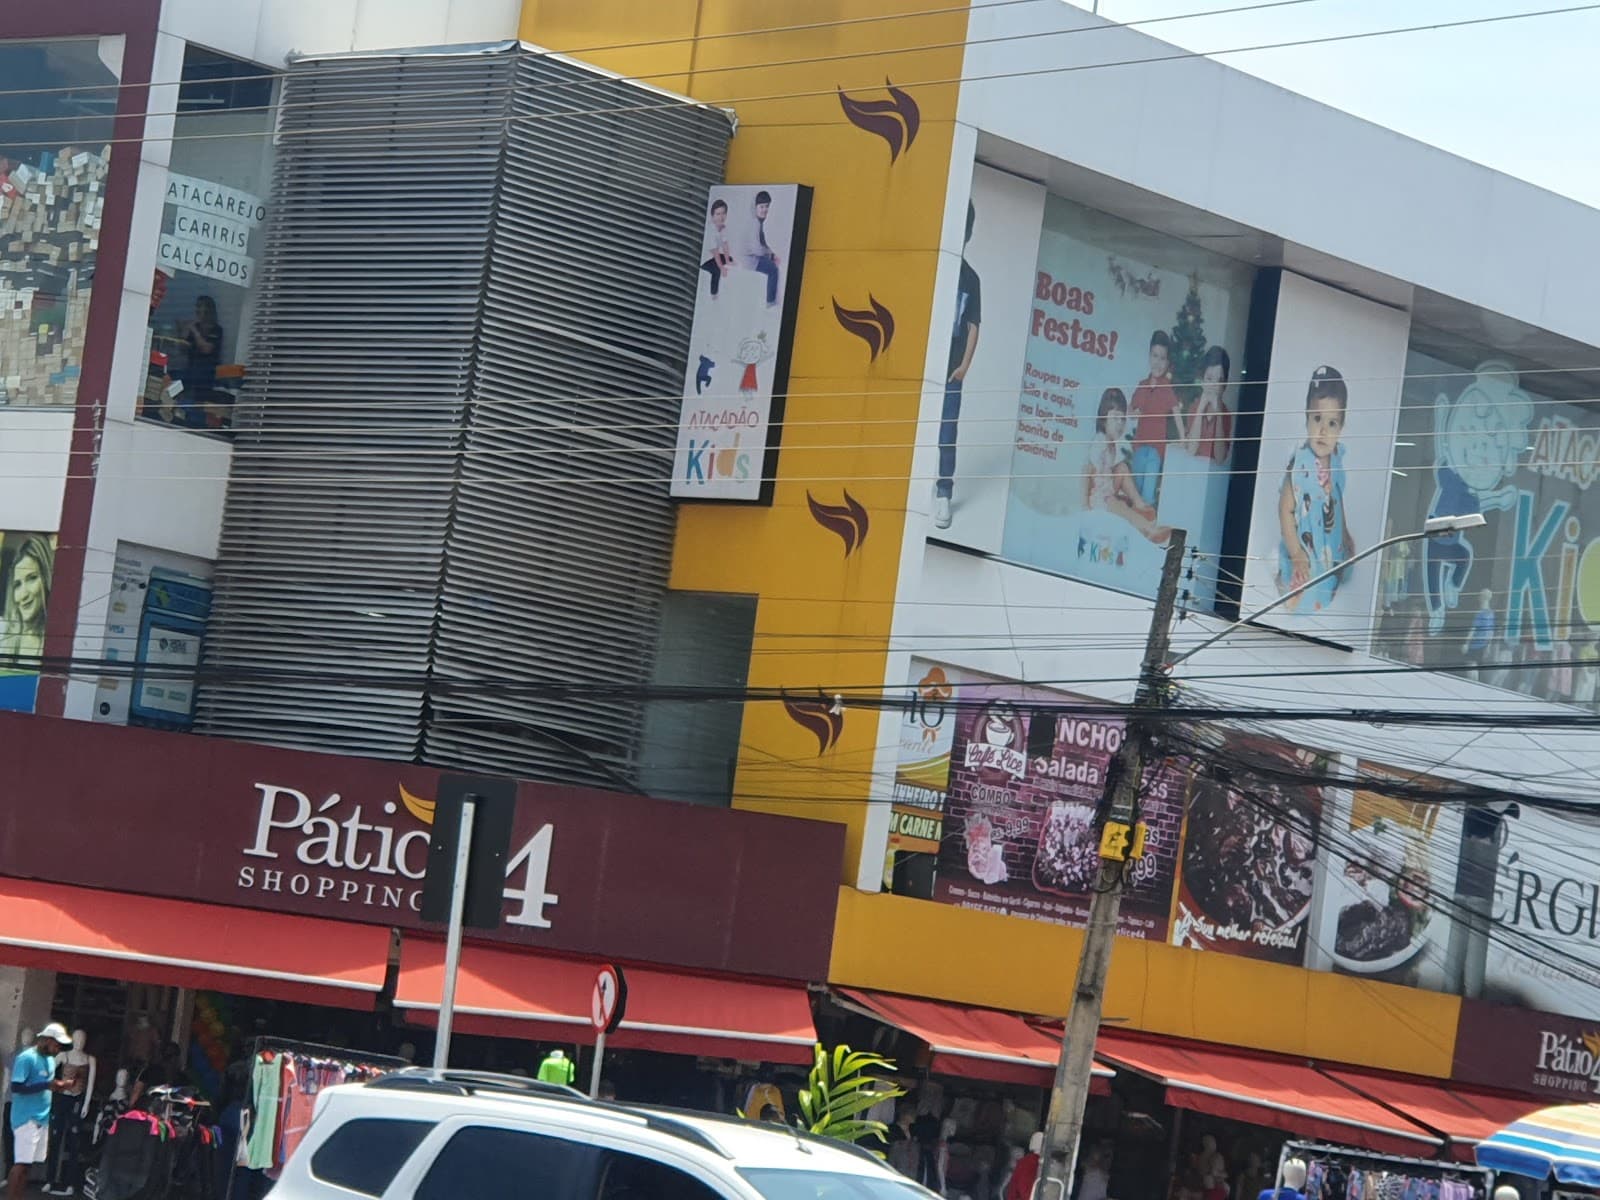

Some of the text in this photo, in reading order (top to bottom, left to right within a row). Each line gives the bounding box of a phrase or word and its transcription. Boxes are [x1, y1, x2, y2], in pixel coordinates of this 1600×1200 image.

[168, 182, 266, 221] ATACAREJO
[178, 216, 245, 248] CARIRIS
[161, 243, 248, 280] CALÇADOS
[1036, 271, 1095, 315] Boas
[1031, 308, 1119, 360] Festas!
[686, 432, 751, 486] Kids
[971, 785, 1010, 806] COMBO
[900, 814, 935, 838] CARNE
